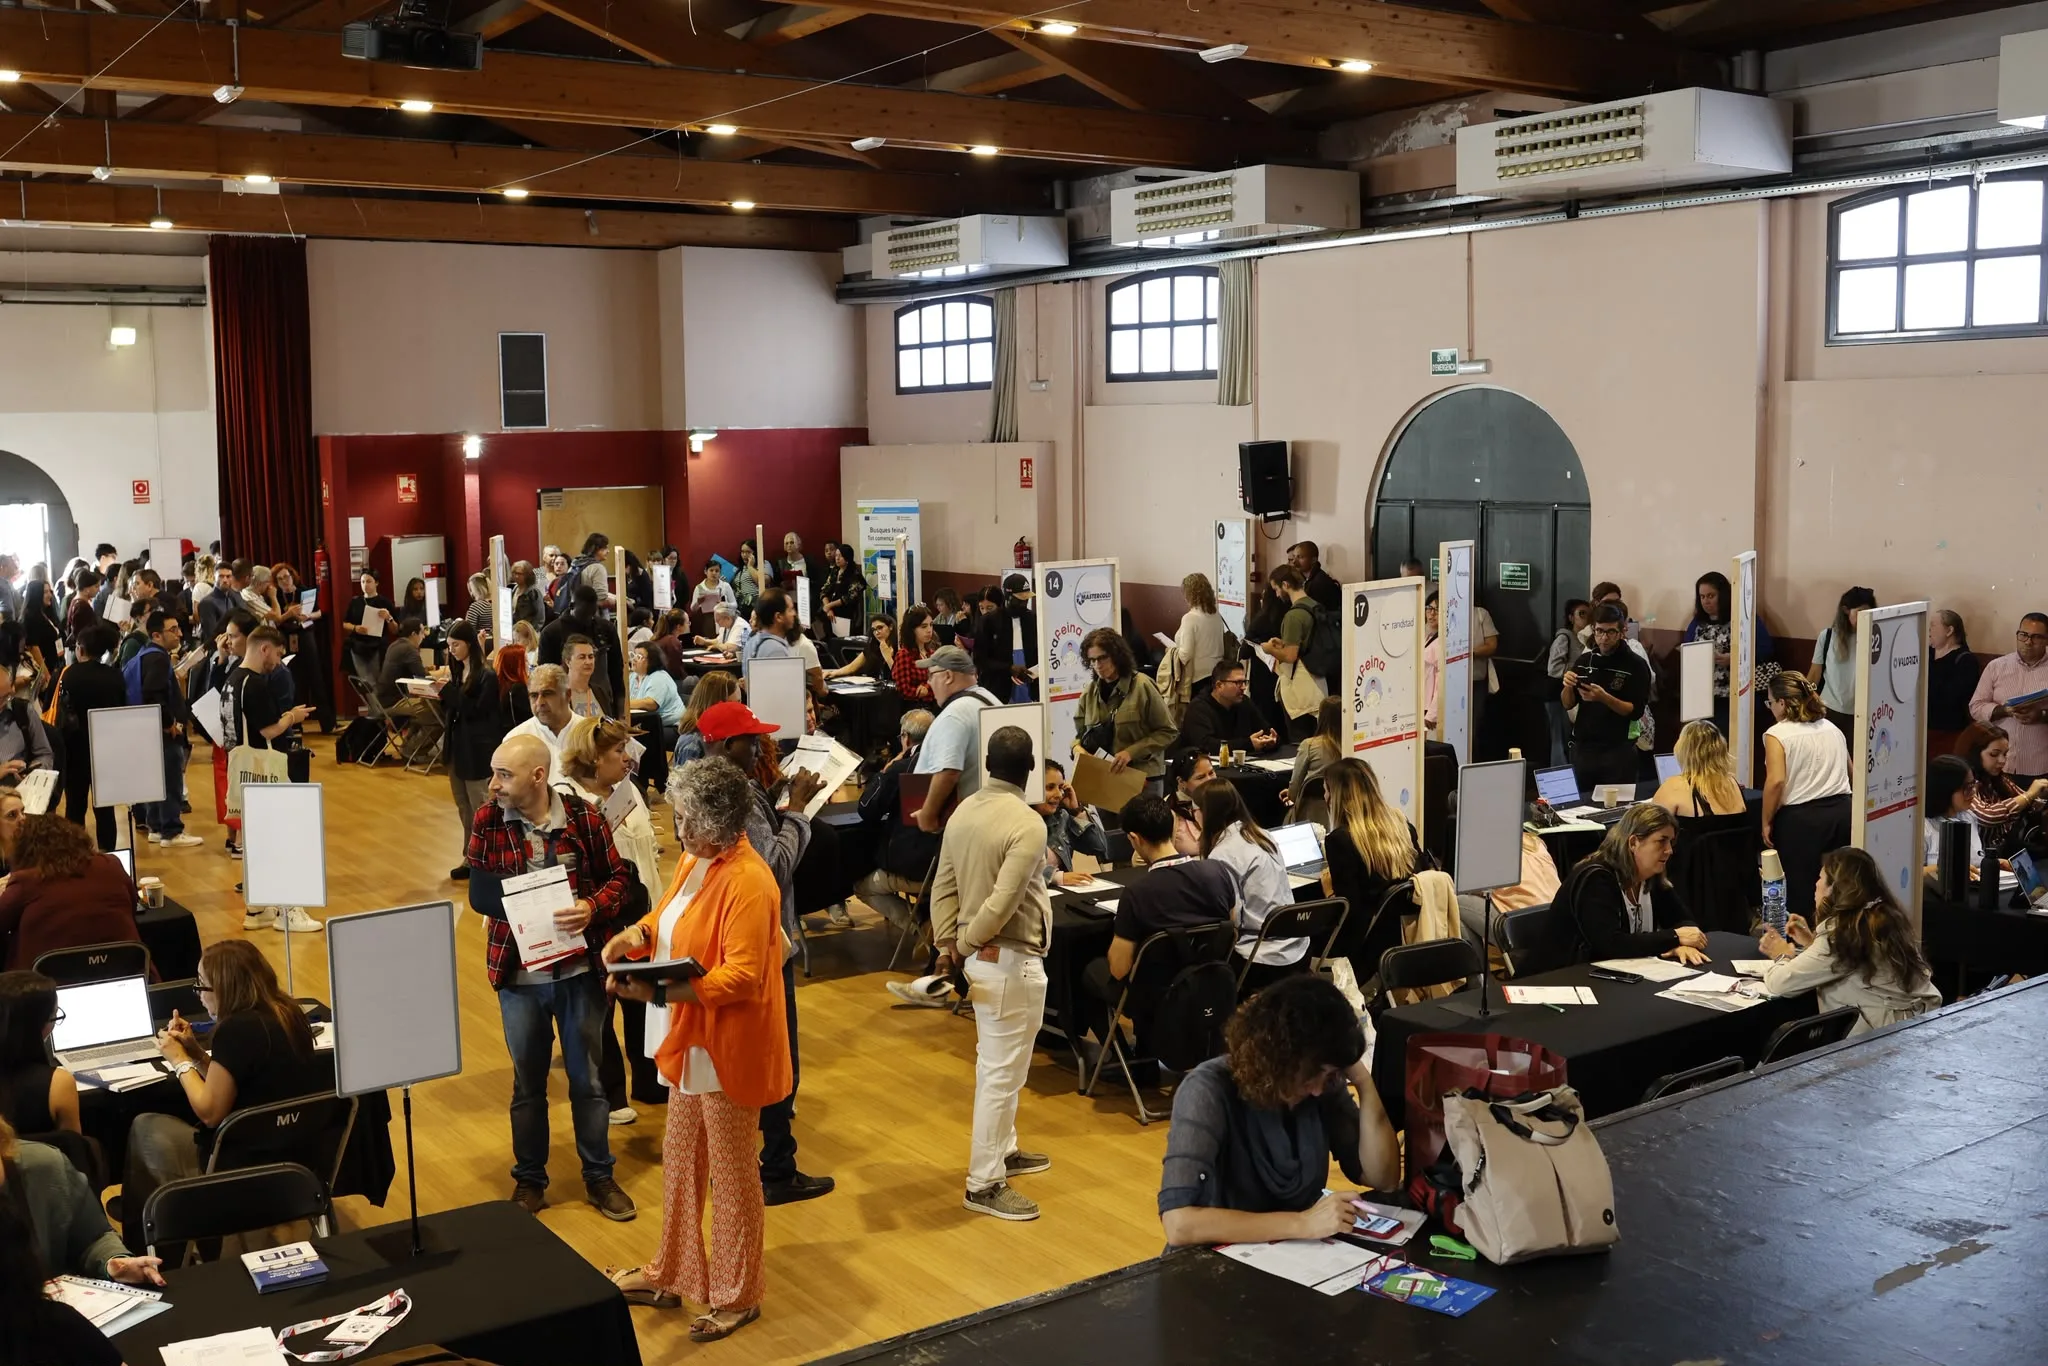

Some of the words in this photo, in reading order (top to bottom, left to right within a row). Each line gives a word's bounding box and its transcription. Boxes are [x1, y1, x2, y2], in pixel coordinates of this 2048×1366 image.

[1049, 577, 1059, 591] 14
[1083, 592, 1111, 600] MASTERCOLD
[1355, 602, 1365, 618] 17
[1391, 616, 1414, 629] randstad
[1297, 911, 1311, 921] MV
[88, 954, 108, 965] MV
[276, 1111, 300, 1127] MV
